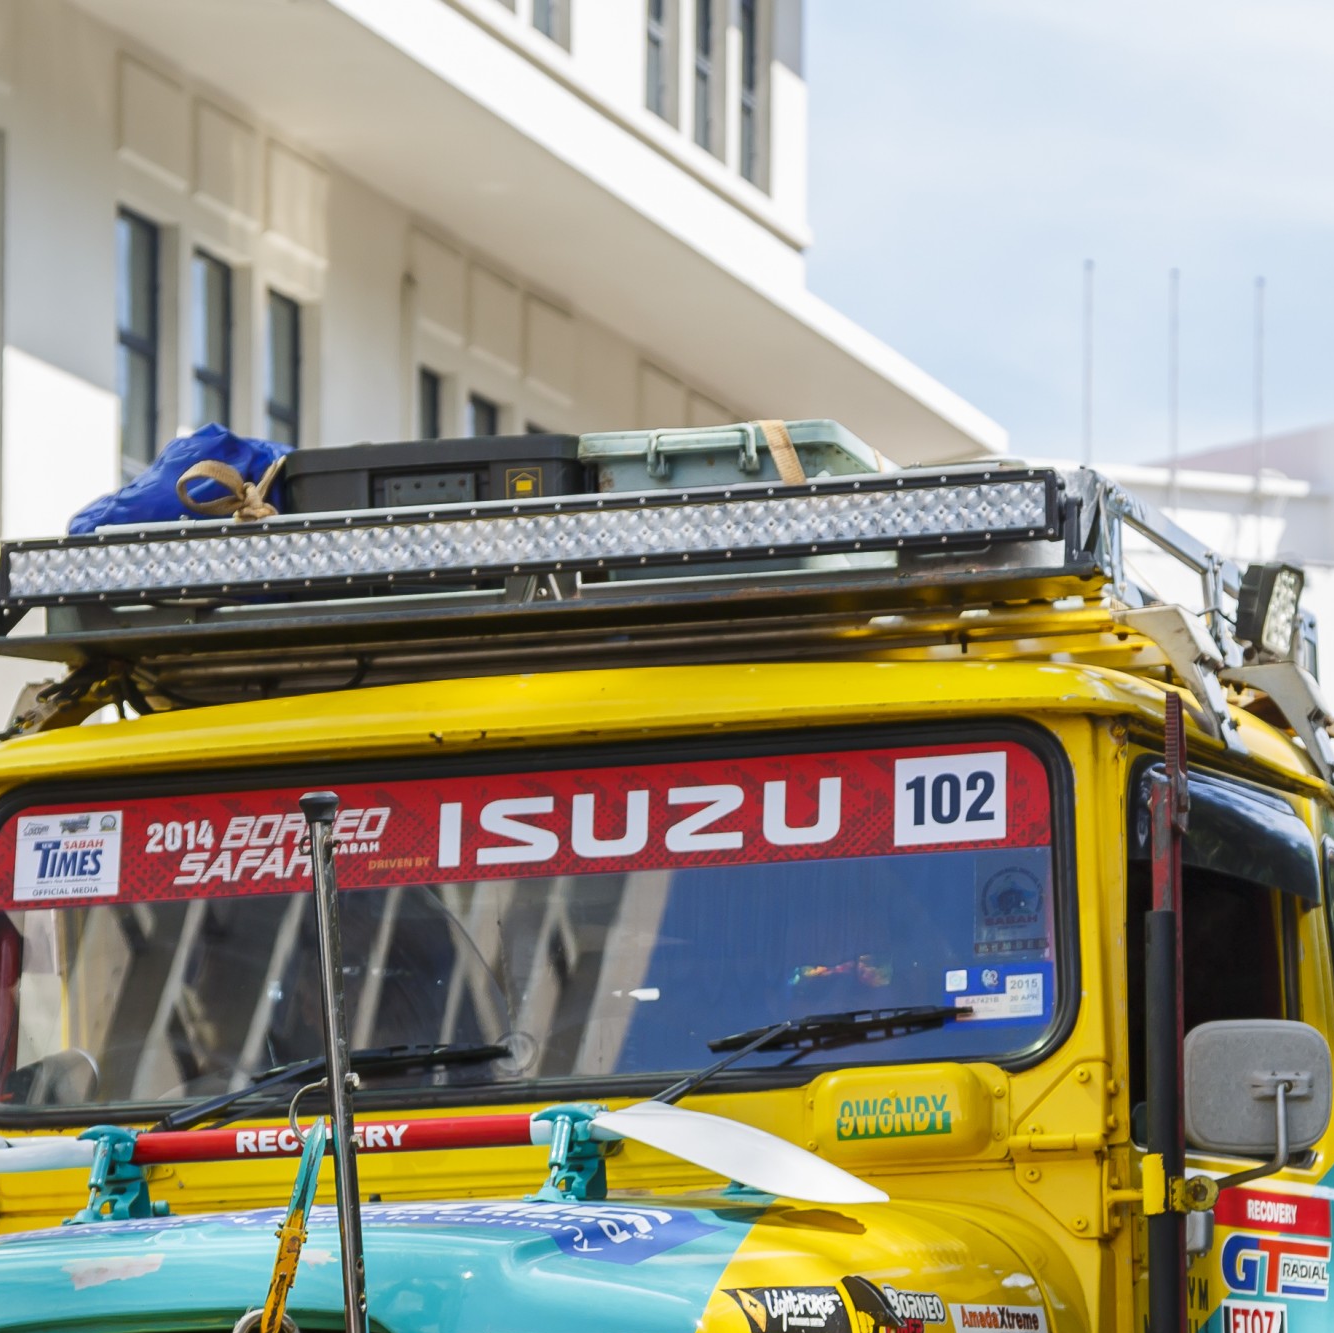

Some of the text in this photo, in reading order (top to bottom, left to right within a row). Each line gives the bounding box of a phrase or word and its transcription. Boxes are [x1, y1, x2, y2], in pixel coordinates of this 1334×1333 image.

[905, 770, 996, 827] 102
[145, 807, 391, 853] 2014 BOREO
[437, 776, 842, 868] ISUZU
[63, 839, 104, 850] SABAH
[33, 840, 103, 878] TIMES
[368, 857, 431, 870] DRIVEN BY
[32, 886, 99, 897] OFFICIAL MEDIA
[1010, 979, 1038, 990] 2015
[1247, 1199, 1298, 1225] RECOVERY
[1282, 1262, 1328, 1281] RADIAL
[885, 1287, 945, 1321] BORNEO
